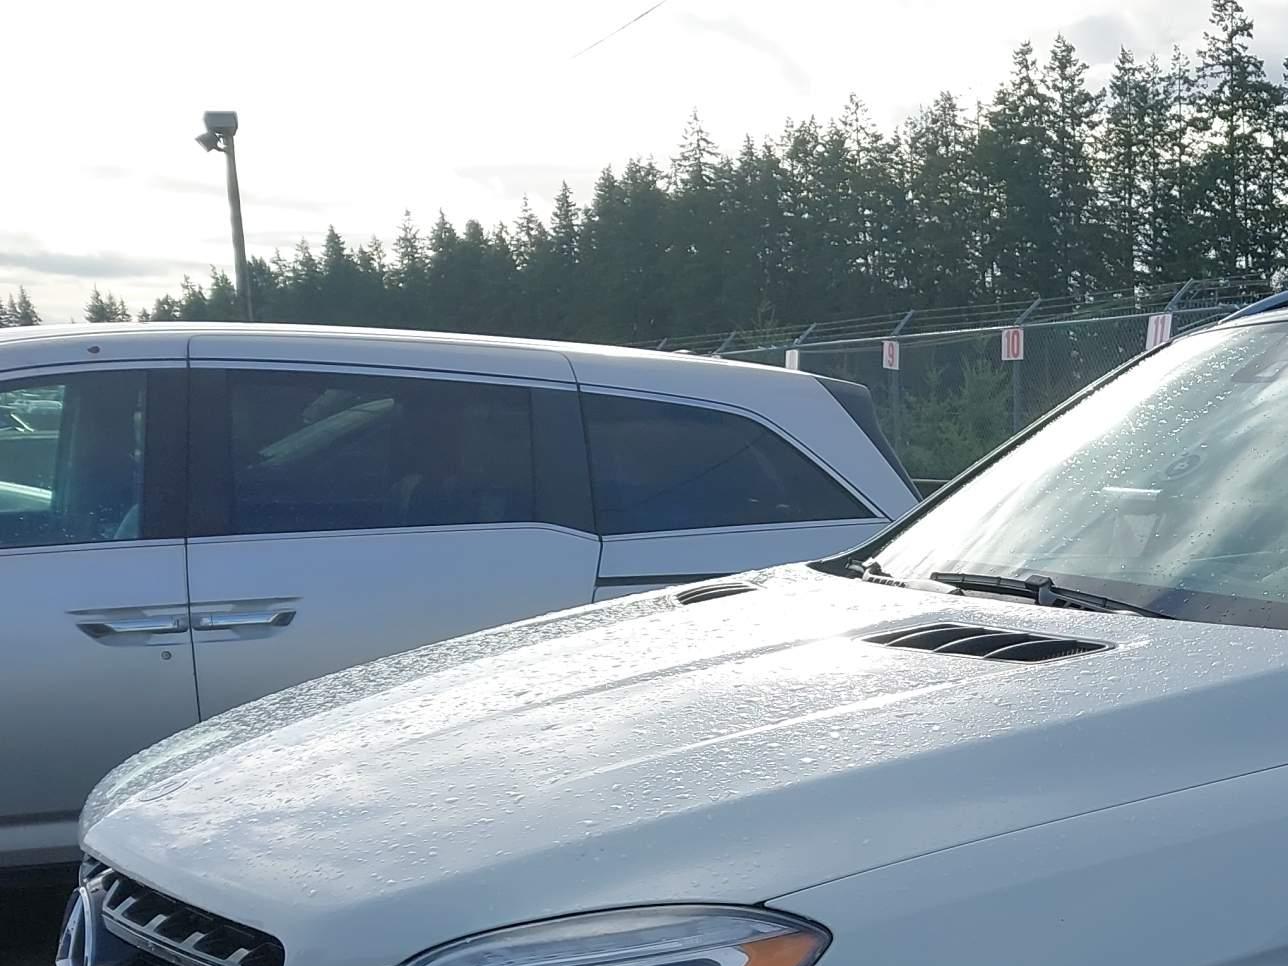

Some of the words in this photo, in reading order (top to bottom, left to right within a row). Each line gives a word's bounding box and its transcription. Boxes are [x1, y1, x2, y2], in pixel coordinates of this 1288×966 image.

[1005, 330, 1020, 358] 10
[1153, 315, 1166, 346] 11
[887, 342, 896, 367] 9
